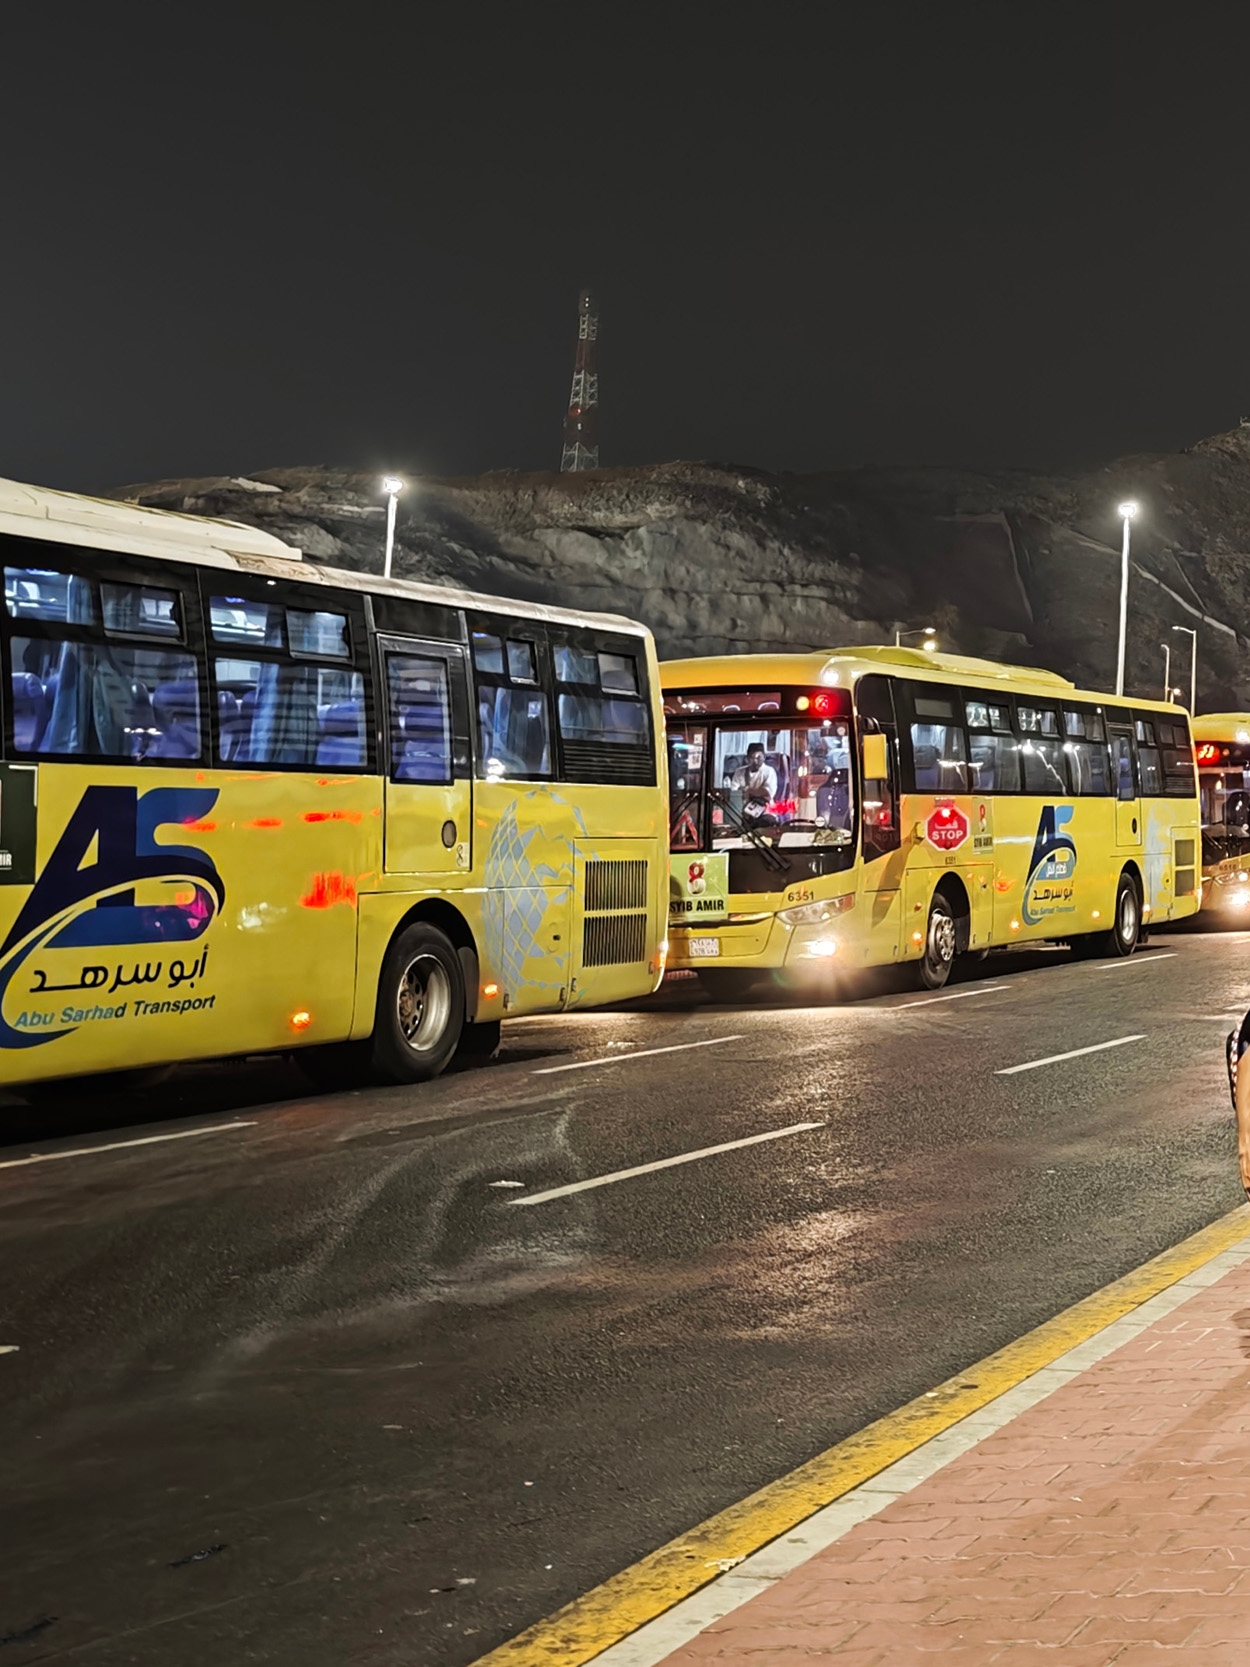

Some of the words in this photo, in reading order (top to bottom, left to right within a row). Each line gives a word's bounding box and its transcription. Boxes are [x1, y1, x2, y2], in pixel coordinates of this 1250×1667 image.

[931, 830, 964, 840] STOP
[670, 901, 693, 912] SYIB
[696, 900, 724, 911] AMIR
[788, 891, 814, 901] 6351
[168, 944, 209, 988] أبو
[29, 962, 162, 994] سرهد
[14, 1011, 54, 1028] Abu
[60, 1003, 127, 1024] Sarhad
[134, 995, 216, 1017] Transport
